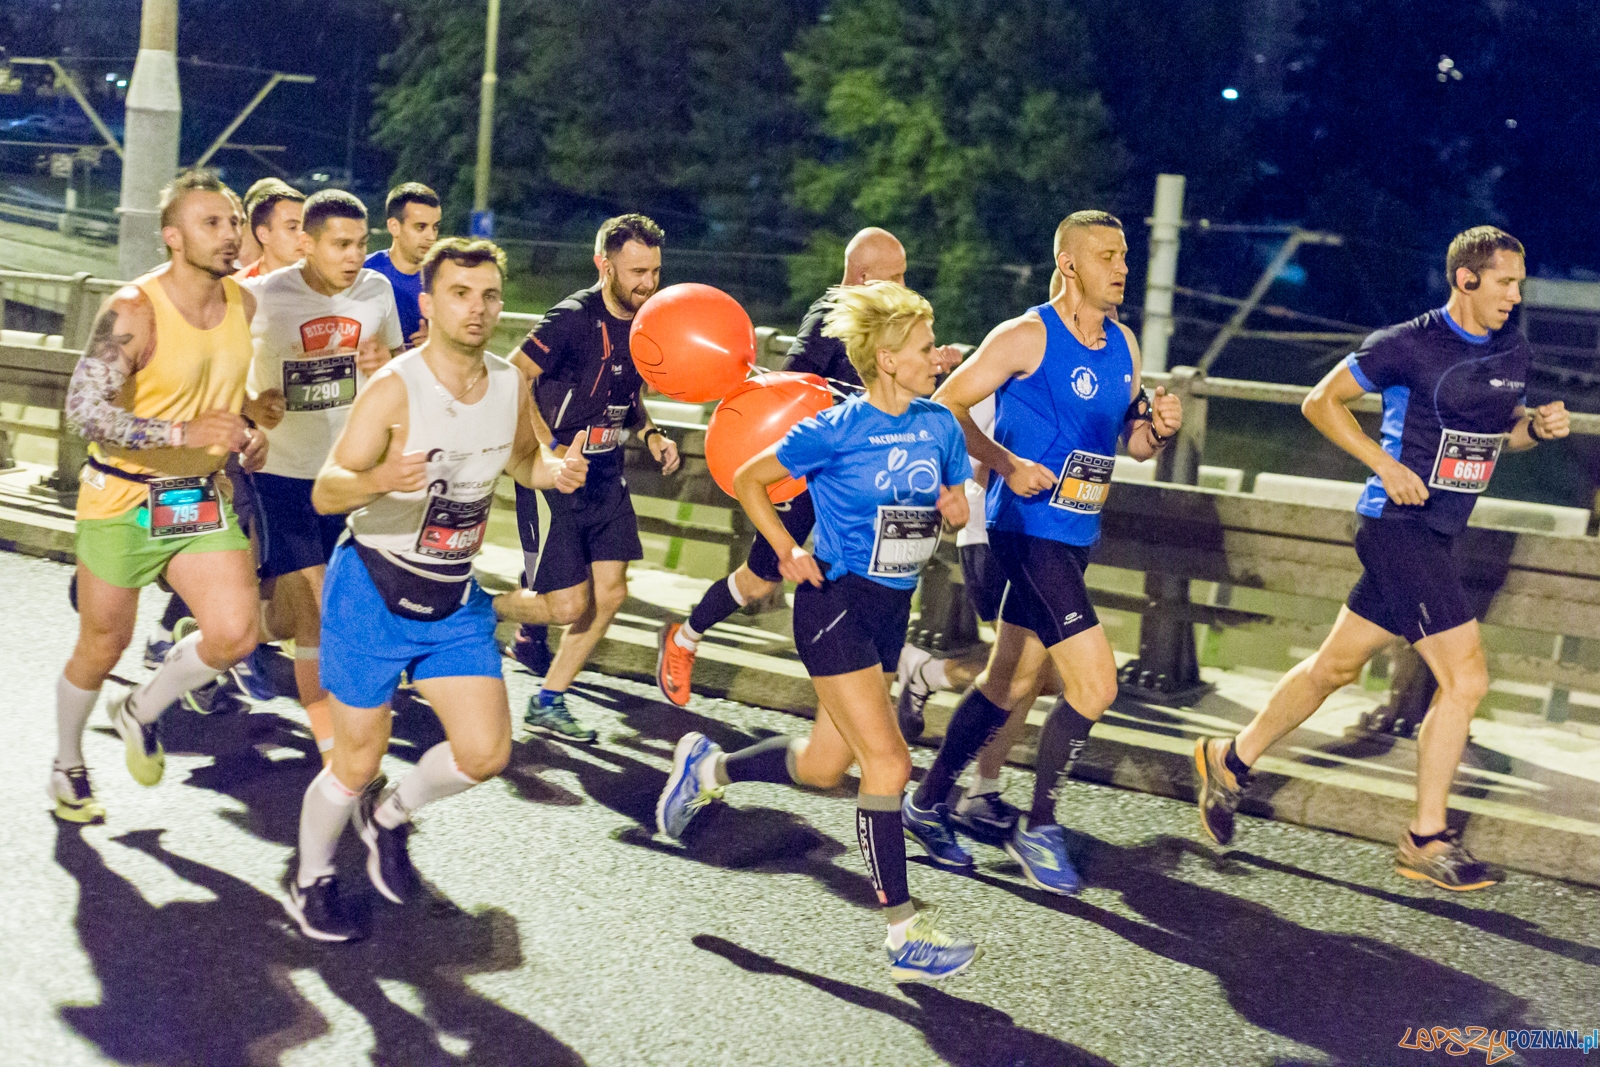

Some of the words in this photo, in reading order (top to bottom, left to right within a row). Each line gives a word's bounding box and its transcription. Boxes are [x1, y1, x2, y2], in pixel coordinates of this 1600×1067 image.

[304, 322, 357, 338] BIEGAM
[302, 382, 340, 402] 7290
[868, 432, 917, 445] PACEMAKER
[1453, 460, 1487, 480] 6631
[172, 504, 199, 524] 795
[446, 524, 482, 549] 4694
[398, 597, 434, 614] Reebok
